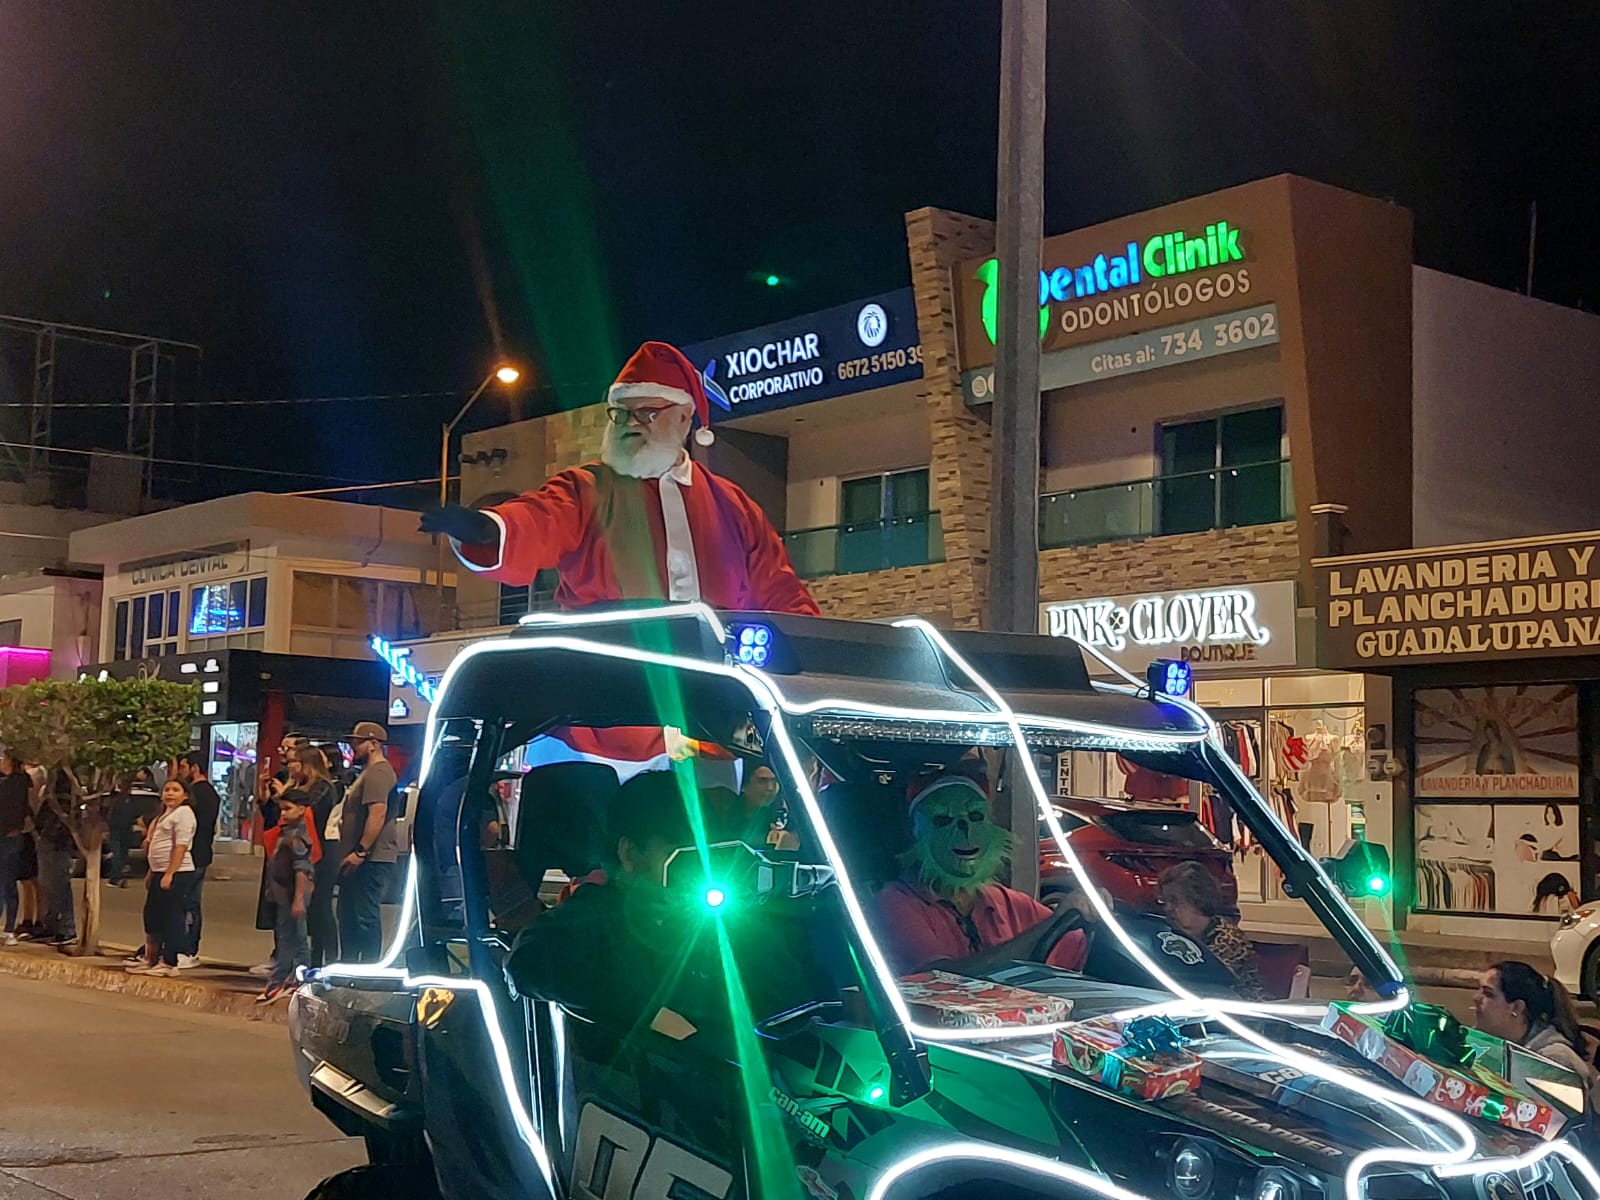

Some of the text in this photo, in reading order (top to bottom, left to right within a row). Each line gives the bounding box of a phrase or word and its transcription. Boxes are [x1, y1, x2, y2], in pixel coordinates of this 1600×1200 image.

[1143, 221, 1243, 278] Clinik
[1061, 269, 1250, 333] ODONTÓLOGOS
[725, 333, 820, 378] XIOCHAR
[838, 357, 870, 380] 6672
[871, 349, 906, 373] 5150
[1091, 313, 1276, 373] Citas al: 734 3602
[729, 367, 823, 404] CORPORATIVO
[181, 557, 228, 577] DENTAL
[1329, 546, 1595, 596] LAVANDERIA Y
[1045, 591, 1270, 649] PINK CLOVER
[1180, 642, 1256, 663] BOUTIQUE
[769, 1087, 830, 1138] can-am
